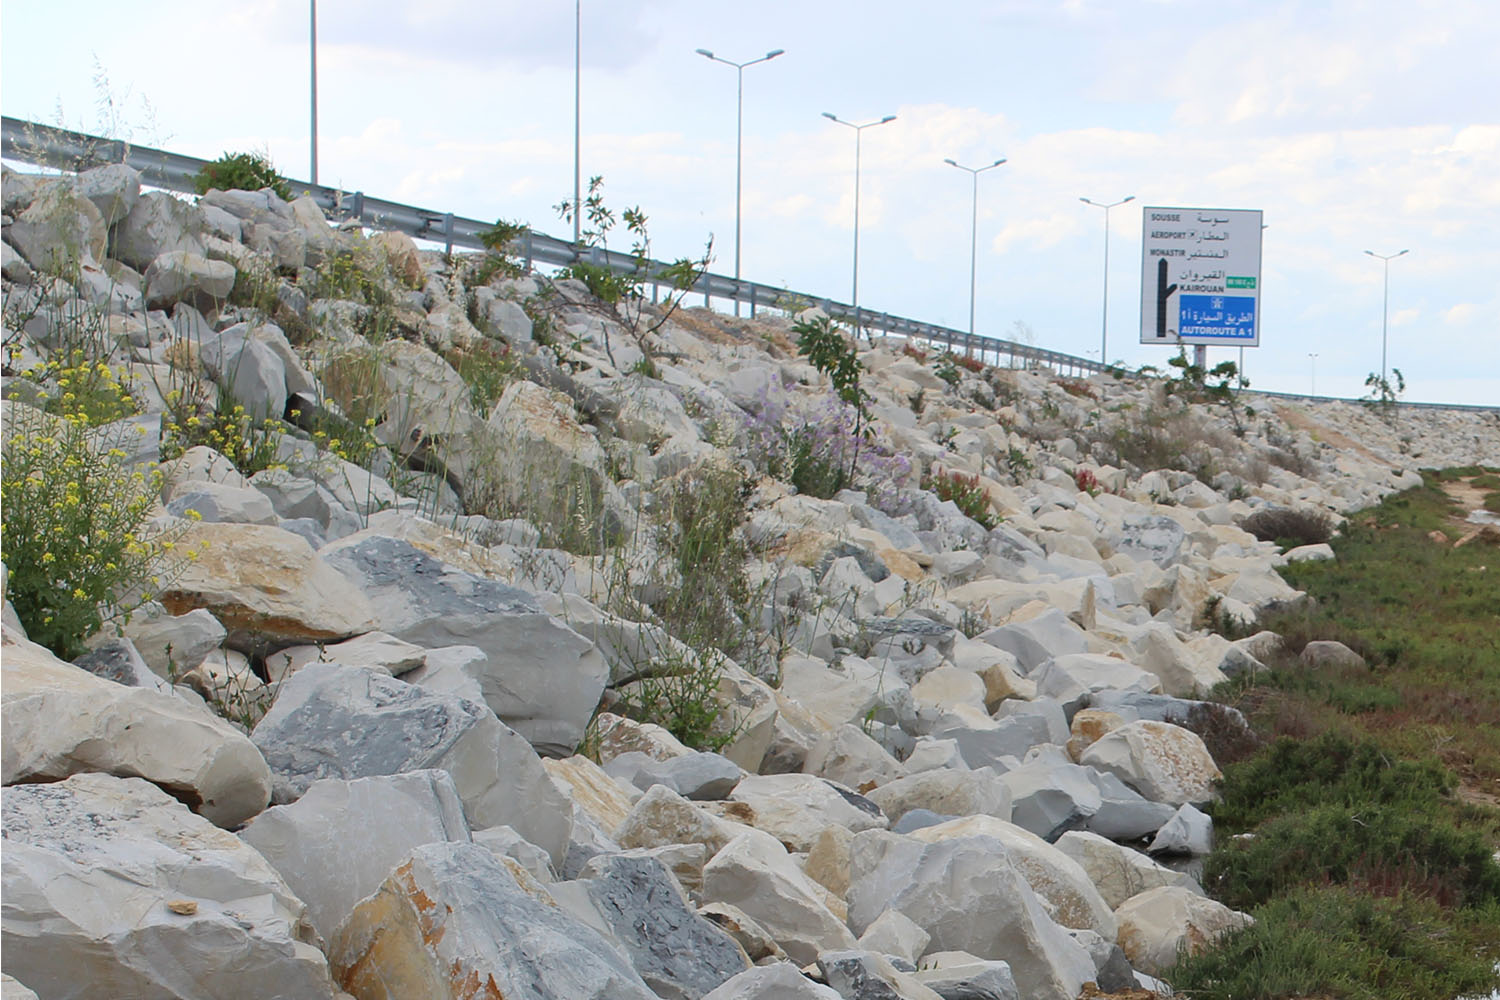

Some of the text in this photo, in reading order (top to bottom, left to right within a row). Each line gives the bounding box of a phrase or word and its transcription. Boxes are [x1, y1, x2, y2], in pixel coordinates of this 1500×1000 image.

[1151, 213, 1181, 222] SOUSSE
[1197, 212, 1229, 227] سوسة
[1150, 231, 1186, 240] AEROPORT
[1196, 231, 1229, 244] المطار
[1150, 248, 1186, 257] MONASTIR
[1186, 248, 1229, 261] المنستير
[1179, 270, 1225, 282] القيروان
[1179, 284, 1225, 293] KAIROUAN
[1193, 310, 1223, 325] السيارة
[1224, 311, 1253, 326] الطريق
[1181, 326, 1236, 335] AUTOROUTE
[1238, 327, 1245, 335] A
